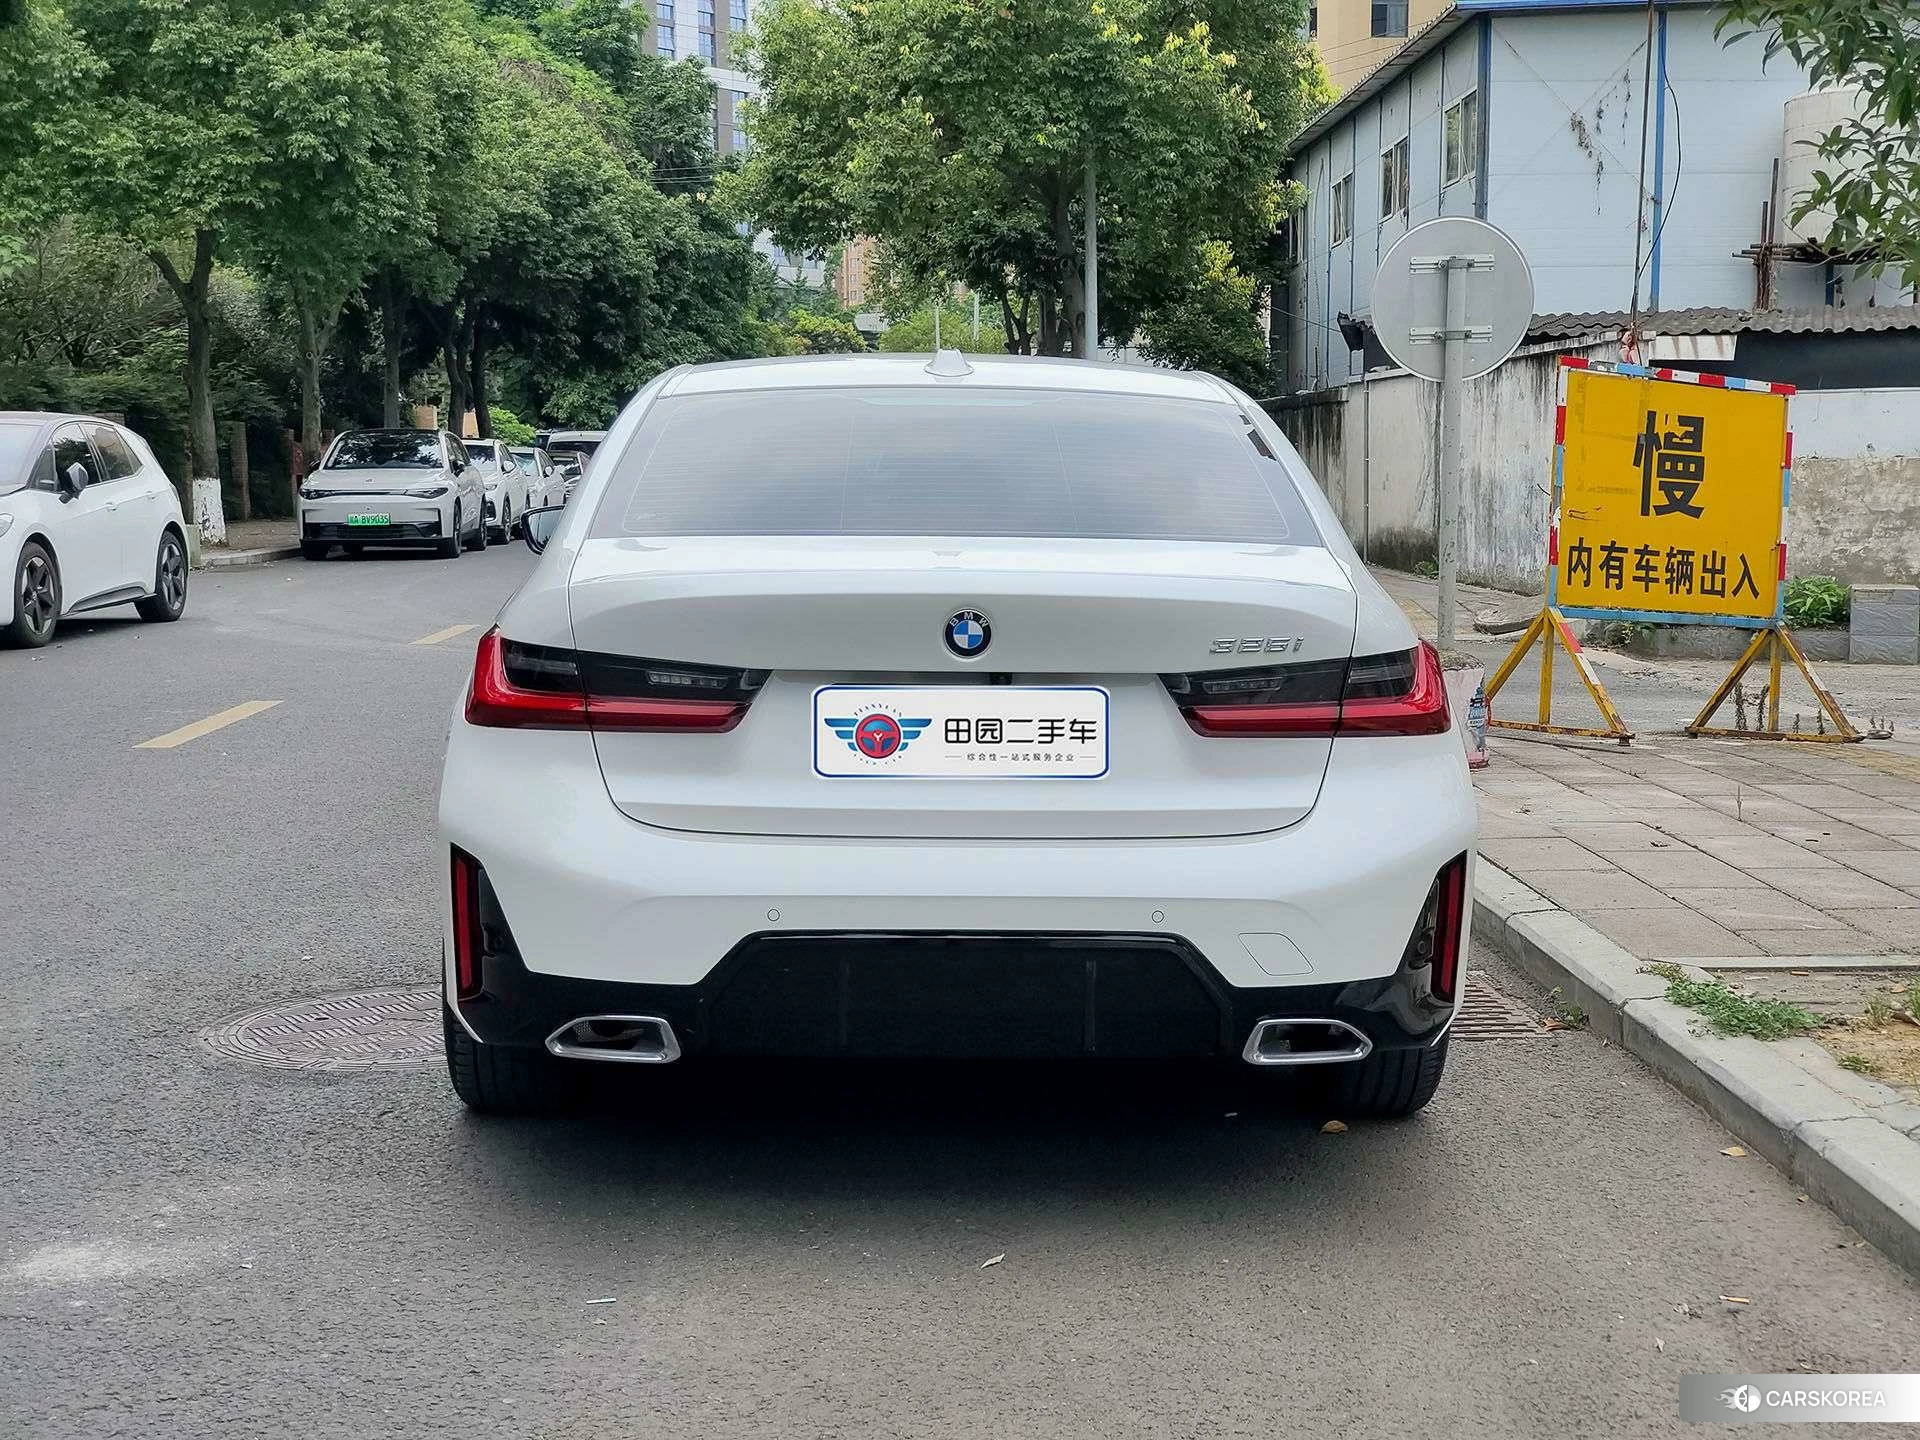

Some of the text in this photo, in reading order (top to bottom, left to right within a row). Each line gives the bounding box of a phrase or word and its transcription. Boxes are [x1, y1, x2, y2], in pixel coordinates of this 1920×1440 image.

[1633, 410, 1705, 519] 慢
[1566, 536, 1761, 600] 内有车辆出入
[949, 611, 989, 628] BMW
[943, 717, 1098, 744] 田园二手车
